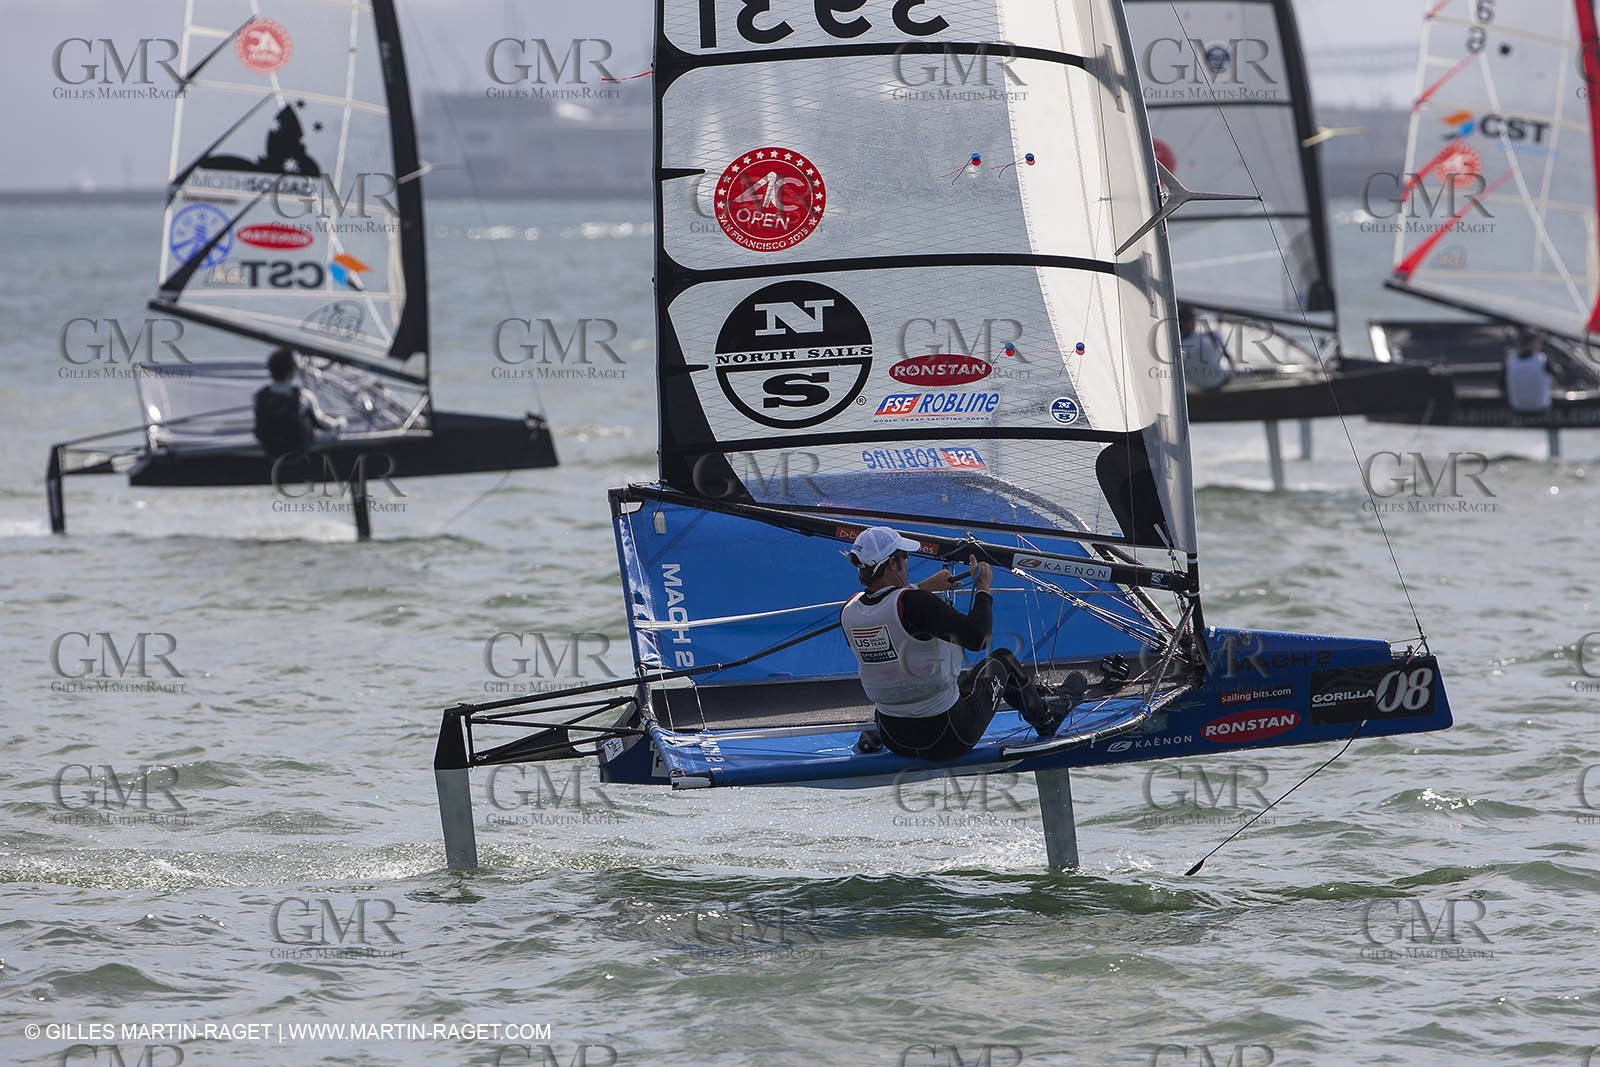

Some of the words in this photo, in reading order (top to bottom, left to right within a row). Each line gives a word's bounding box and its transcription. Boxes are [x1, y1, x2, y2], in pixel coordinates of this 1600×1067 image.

[1479, 114, 1550, 144] CST
[736, 207, 790, 230] OPEN
[718, 213, 734, 232] SAN
[730, 231, 787, 250] FRANCISCO
[754, 299, 835, 336] N
[715, 351, 796, 365] NORTH
[807, 346, 873, 359] SAILS
[893, 364, 986, 377] RONSTAN
[762, 372, 830, 408] S
[882, 396, 914, 413] FSE
[1044, 561, 1108, 578] KAENON
[661, 563, 692, 644] MACH
[855, 638, 870, 648] US
[675, 651, 695, 668] 2
[1221, 692, 1251, 703] sailing
[1252, 686, 1292, 700] bits.com
[1312, 689, 1375, 703] GORILLA
[1376, 667, 1433, 713] 08
[1205, 713, 1296, 737] RONSTAN
